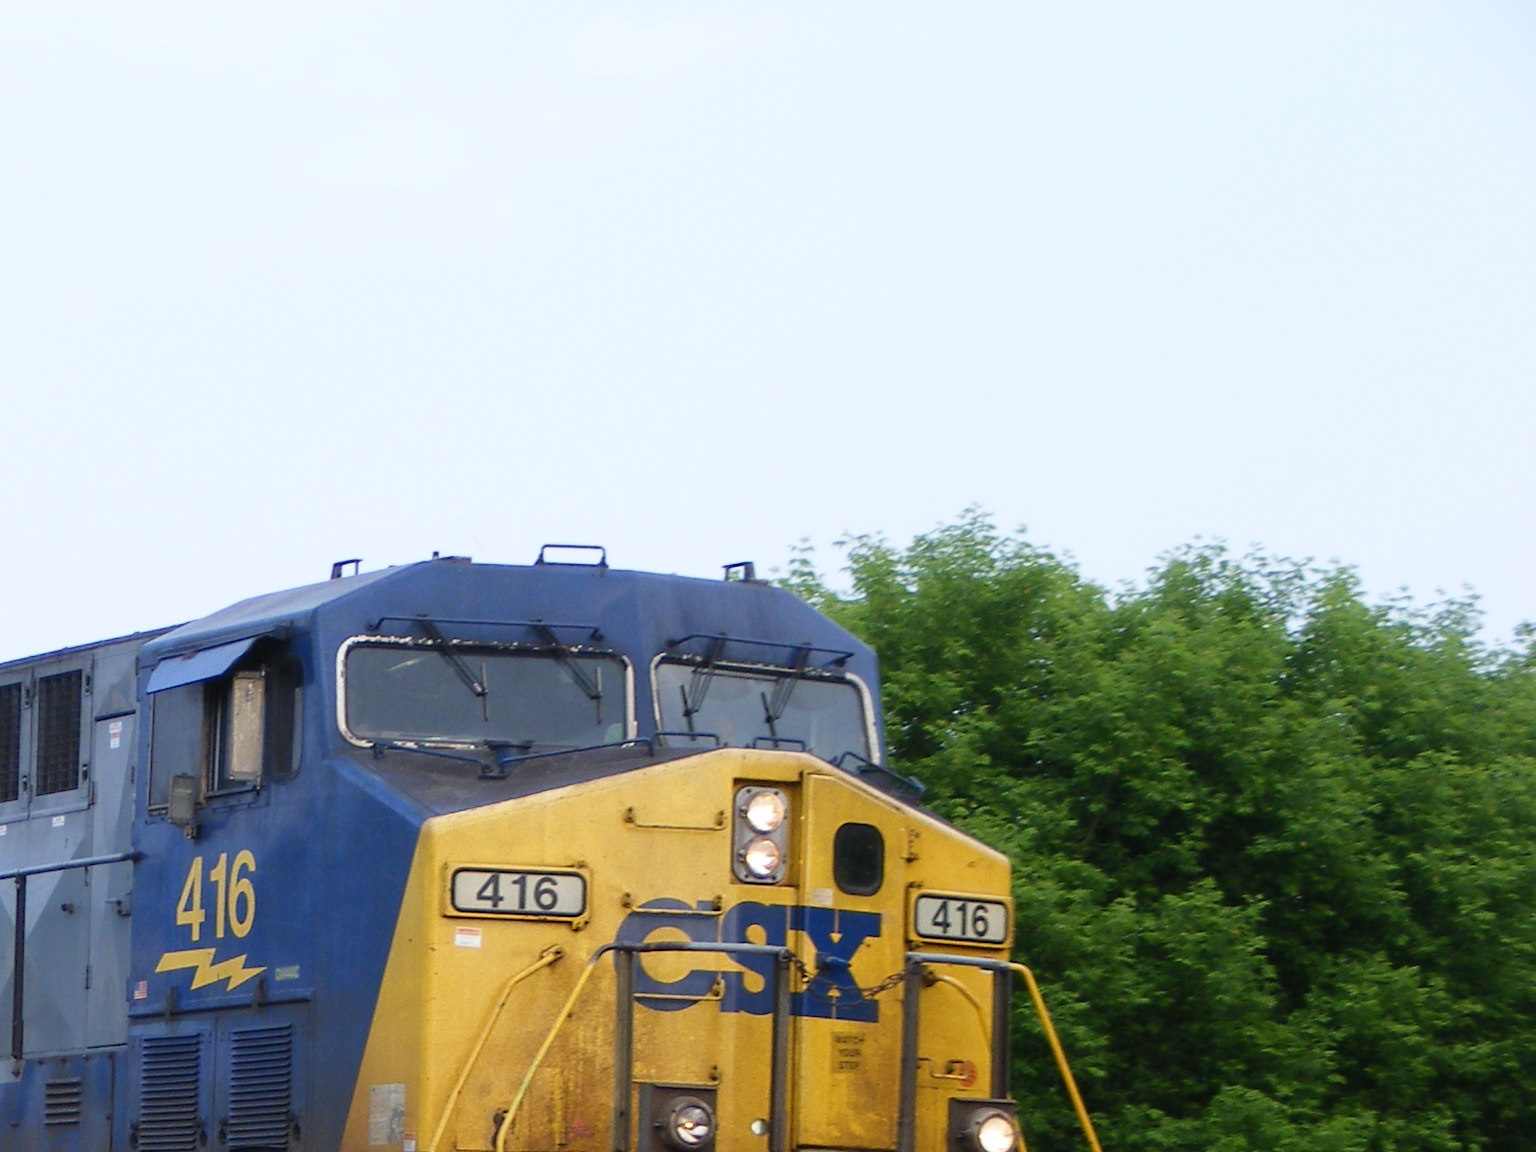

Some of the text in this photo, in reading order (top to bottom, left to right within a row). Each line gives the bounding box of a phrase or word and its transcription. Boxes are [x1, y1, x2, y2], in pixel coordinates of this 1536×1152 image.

[175, 849, 256, 942] 416
[476, 872, 559, 911] 416
[931, 905, 990, 938] 416
[614, 897, 882, 1023] CSX
